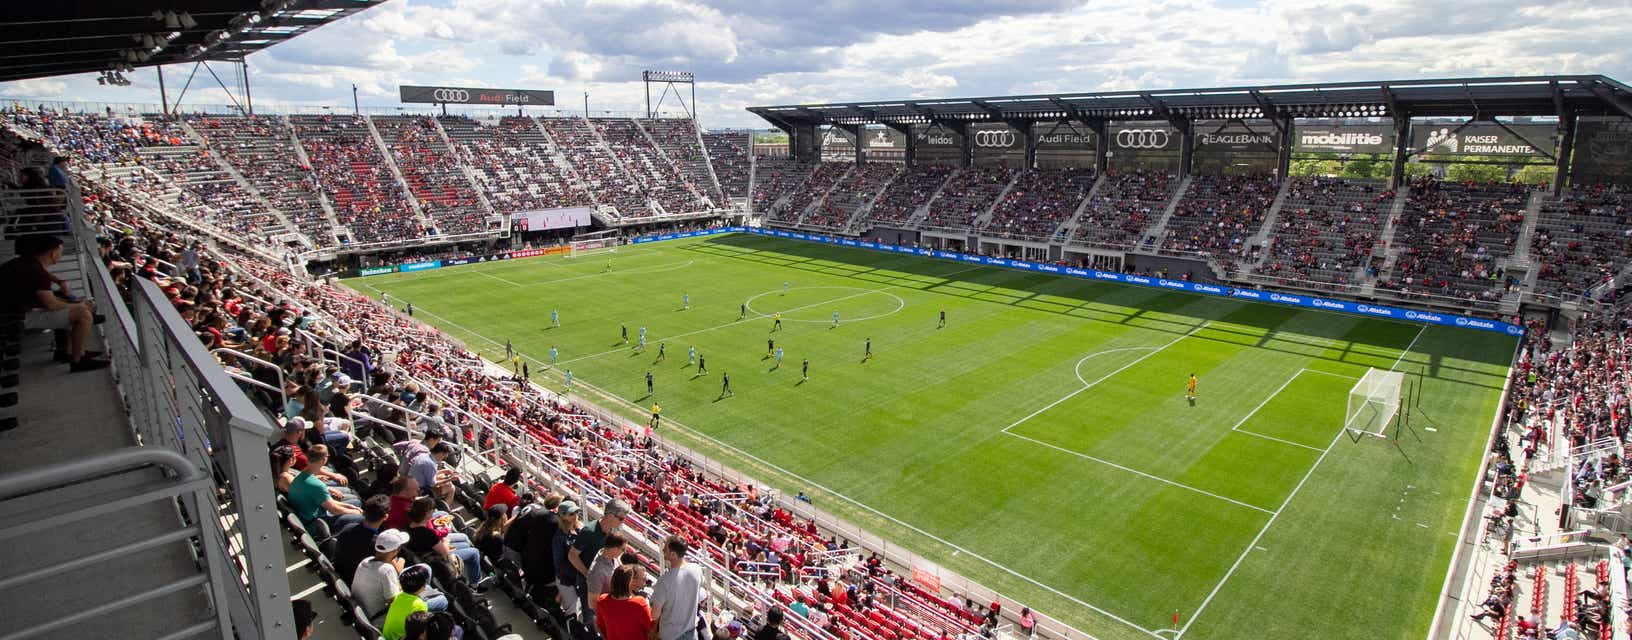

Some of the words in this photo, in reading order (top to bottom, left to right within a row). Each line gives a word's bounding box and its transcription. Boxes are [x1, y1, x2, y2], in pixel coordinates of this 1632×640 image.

[480, 94, 503, 102] Audi
[506, 94, 529, 103] Field
[927, 134, 953, 145] leidos
[1038, 134, 1062, 143] Audi
[1064, 134, 1090, 143] Field
[1301, 132, 1383, 145] mobilitie
[1464, 135, 1498, 144] KAISER
[1463, 145, 1531, 154] PERMANENTE
[1367, 306, 1392, 315] Allstate
[1416, 313, 1443, 322] Allstate
[1466, 319, 1494, 329] Allstate
